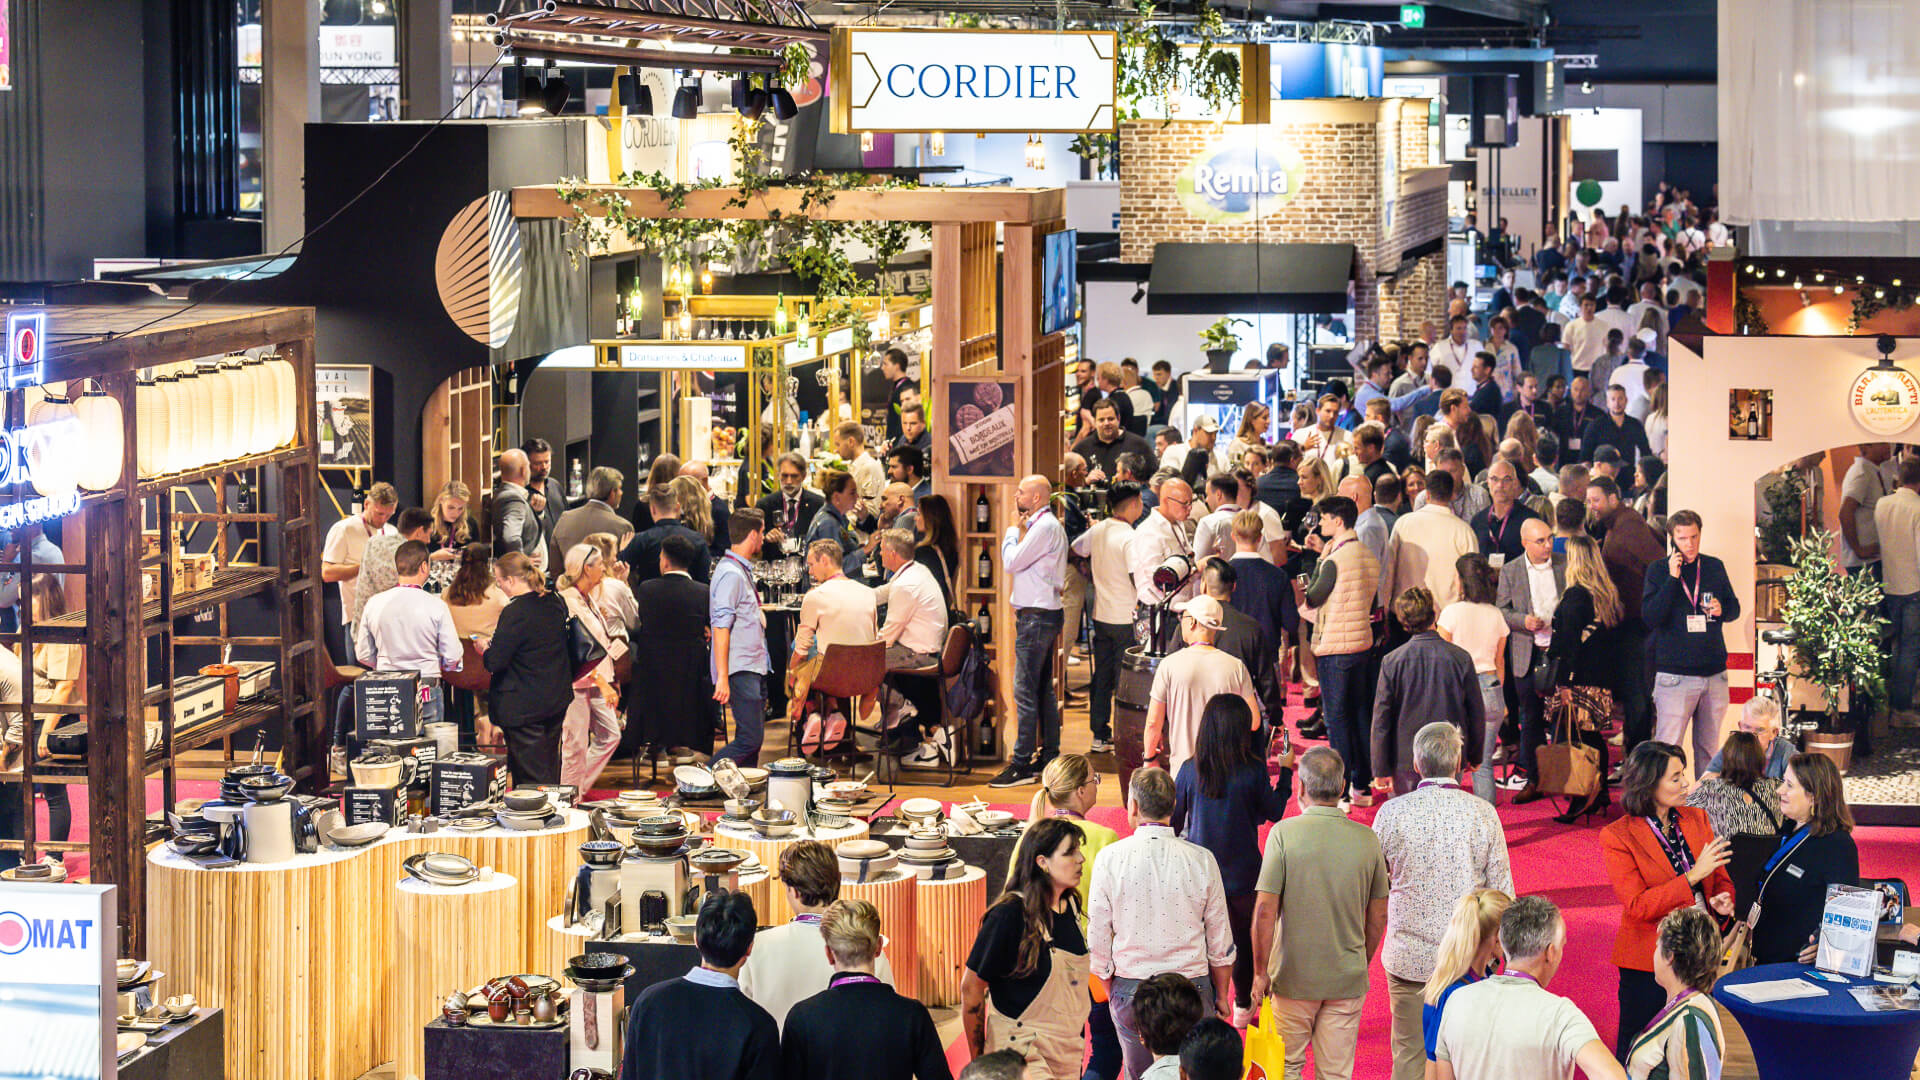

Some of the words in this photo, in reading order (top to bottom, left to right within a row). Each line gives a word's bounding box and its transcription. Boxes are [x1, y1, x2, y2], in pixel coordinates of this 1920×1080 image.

[347, 52, 382, 60] YONG
[887, 64, 1080, 99] CORDIER
[624, 117, 677, 149] CORDIER
[1194, 164, 1288, 200] Remia
[1855, 371, 1878, 406] BIRRA
[969, 420, 1008, 445] BORDEAUX
